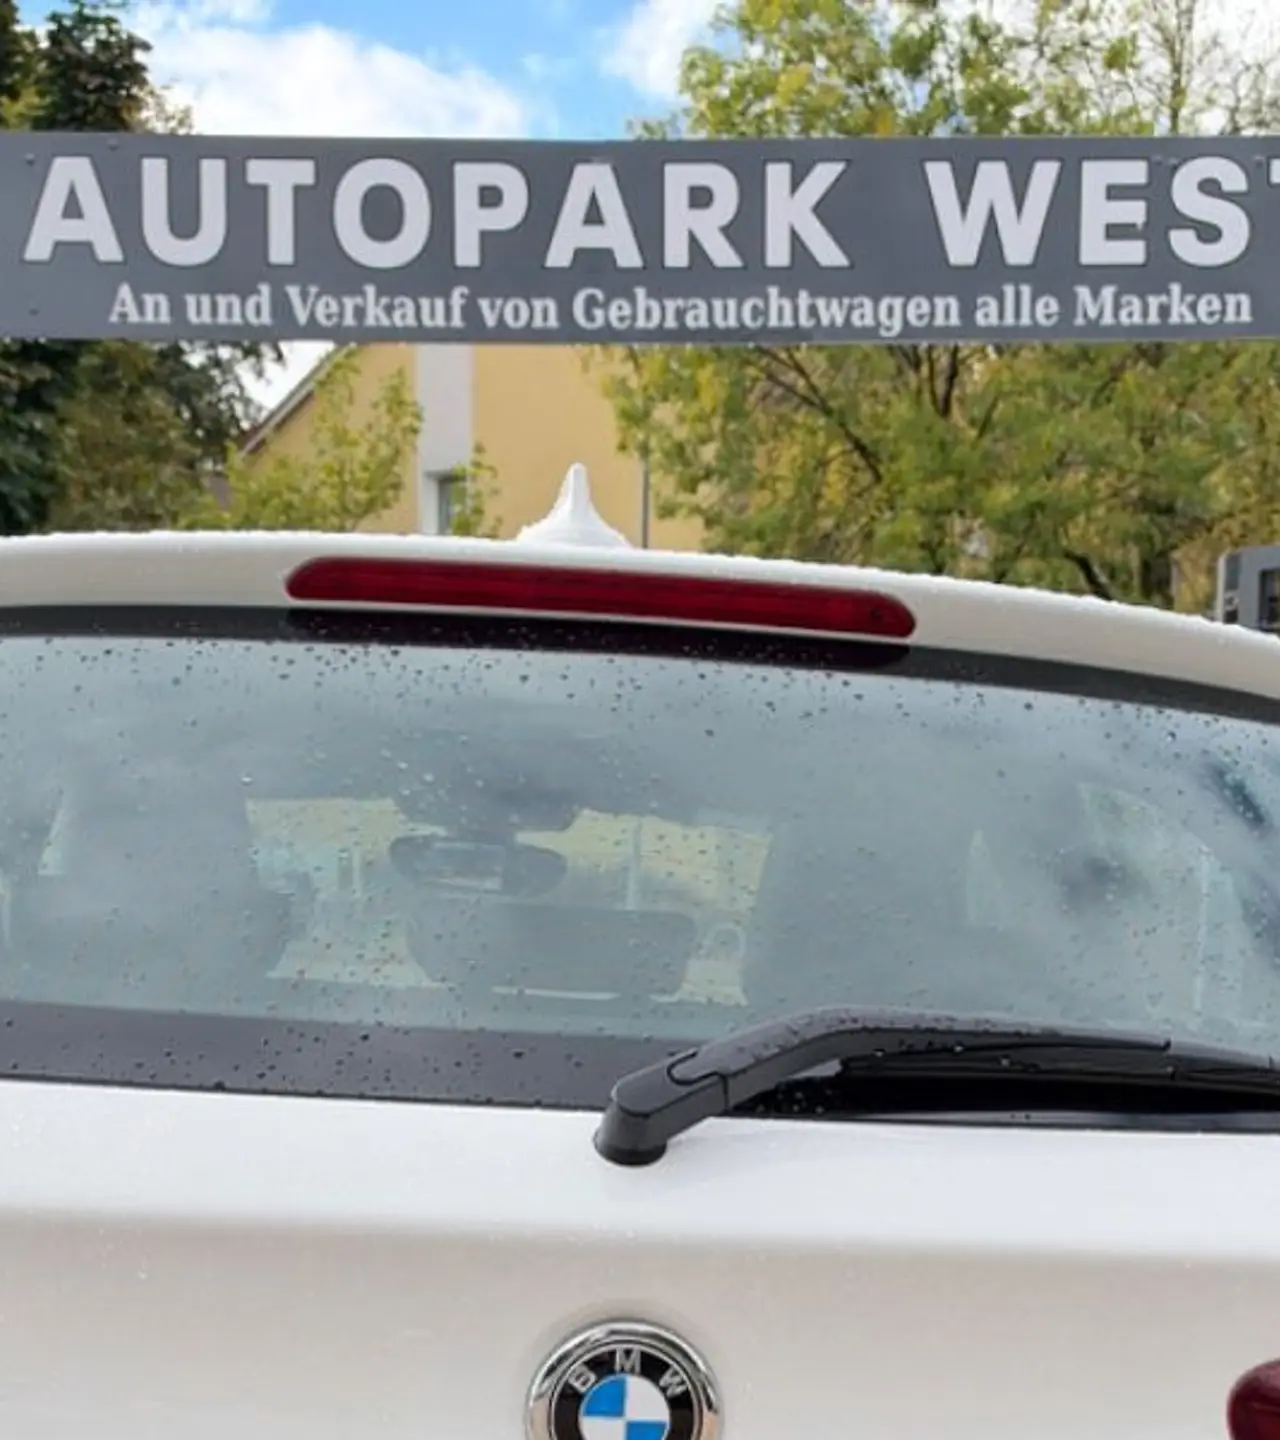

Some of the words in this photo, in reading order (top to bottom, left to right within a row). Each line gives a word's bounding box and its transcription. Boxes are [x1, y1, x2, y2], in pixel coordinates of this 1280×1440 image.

[22, 156, 852, 269] AUTOPARK
[107, 281, 172, 325] An
[183, 282, 273, 327] und
[284, 283, 471, 329] Verkauf
[476, 296, 560, 329] von
[571, 285, 962, 338] Gebrauchtwagen
[974, 283, 1060, 328] alle
[1073, 282, 1253, 327] Marken
[569, 1347, 689, 1399] BMW
